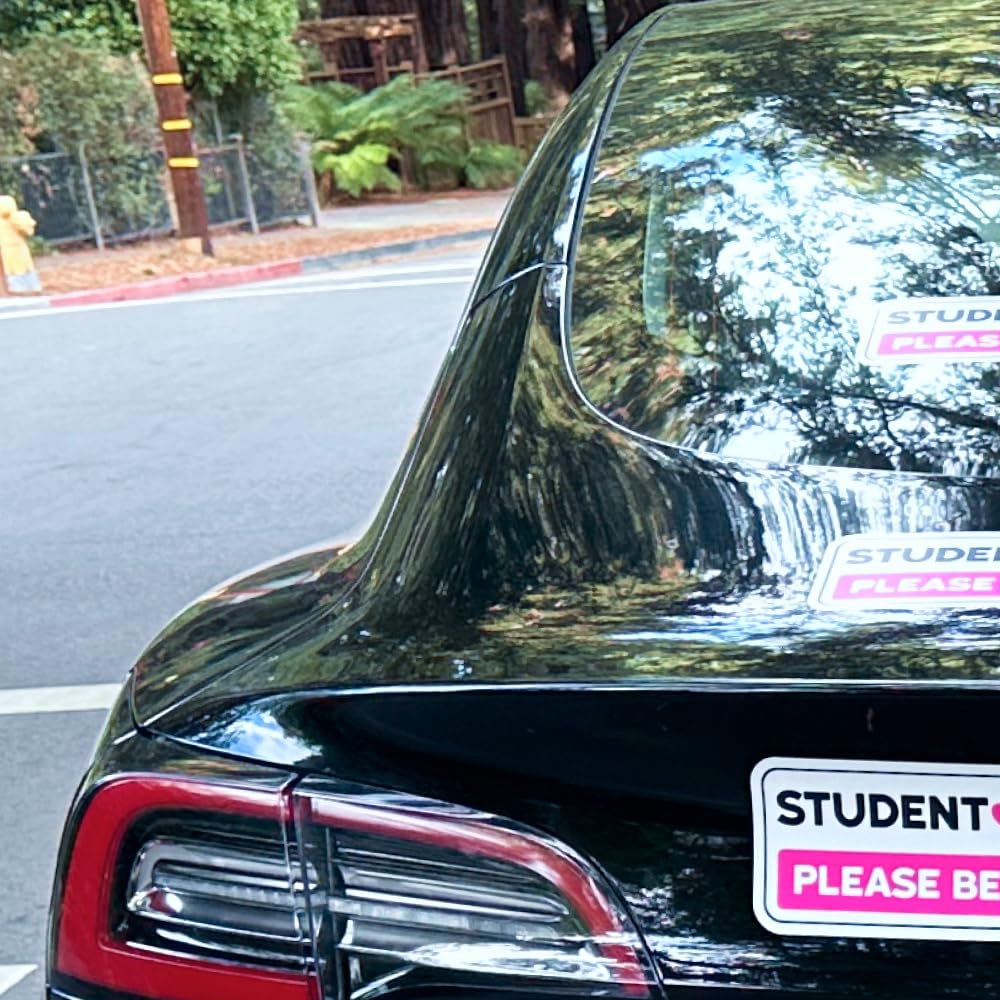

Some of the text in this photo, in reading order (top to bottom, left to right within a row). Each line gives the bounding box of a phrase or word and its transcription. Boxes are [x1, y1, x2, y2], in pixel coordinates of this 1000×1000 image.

[848, 576, 996, 594] PLEASE
[776, 789, 989, 832] STUDENT
[793, 864, 941, 899] PLEASE
